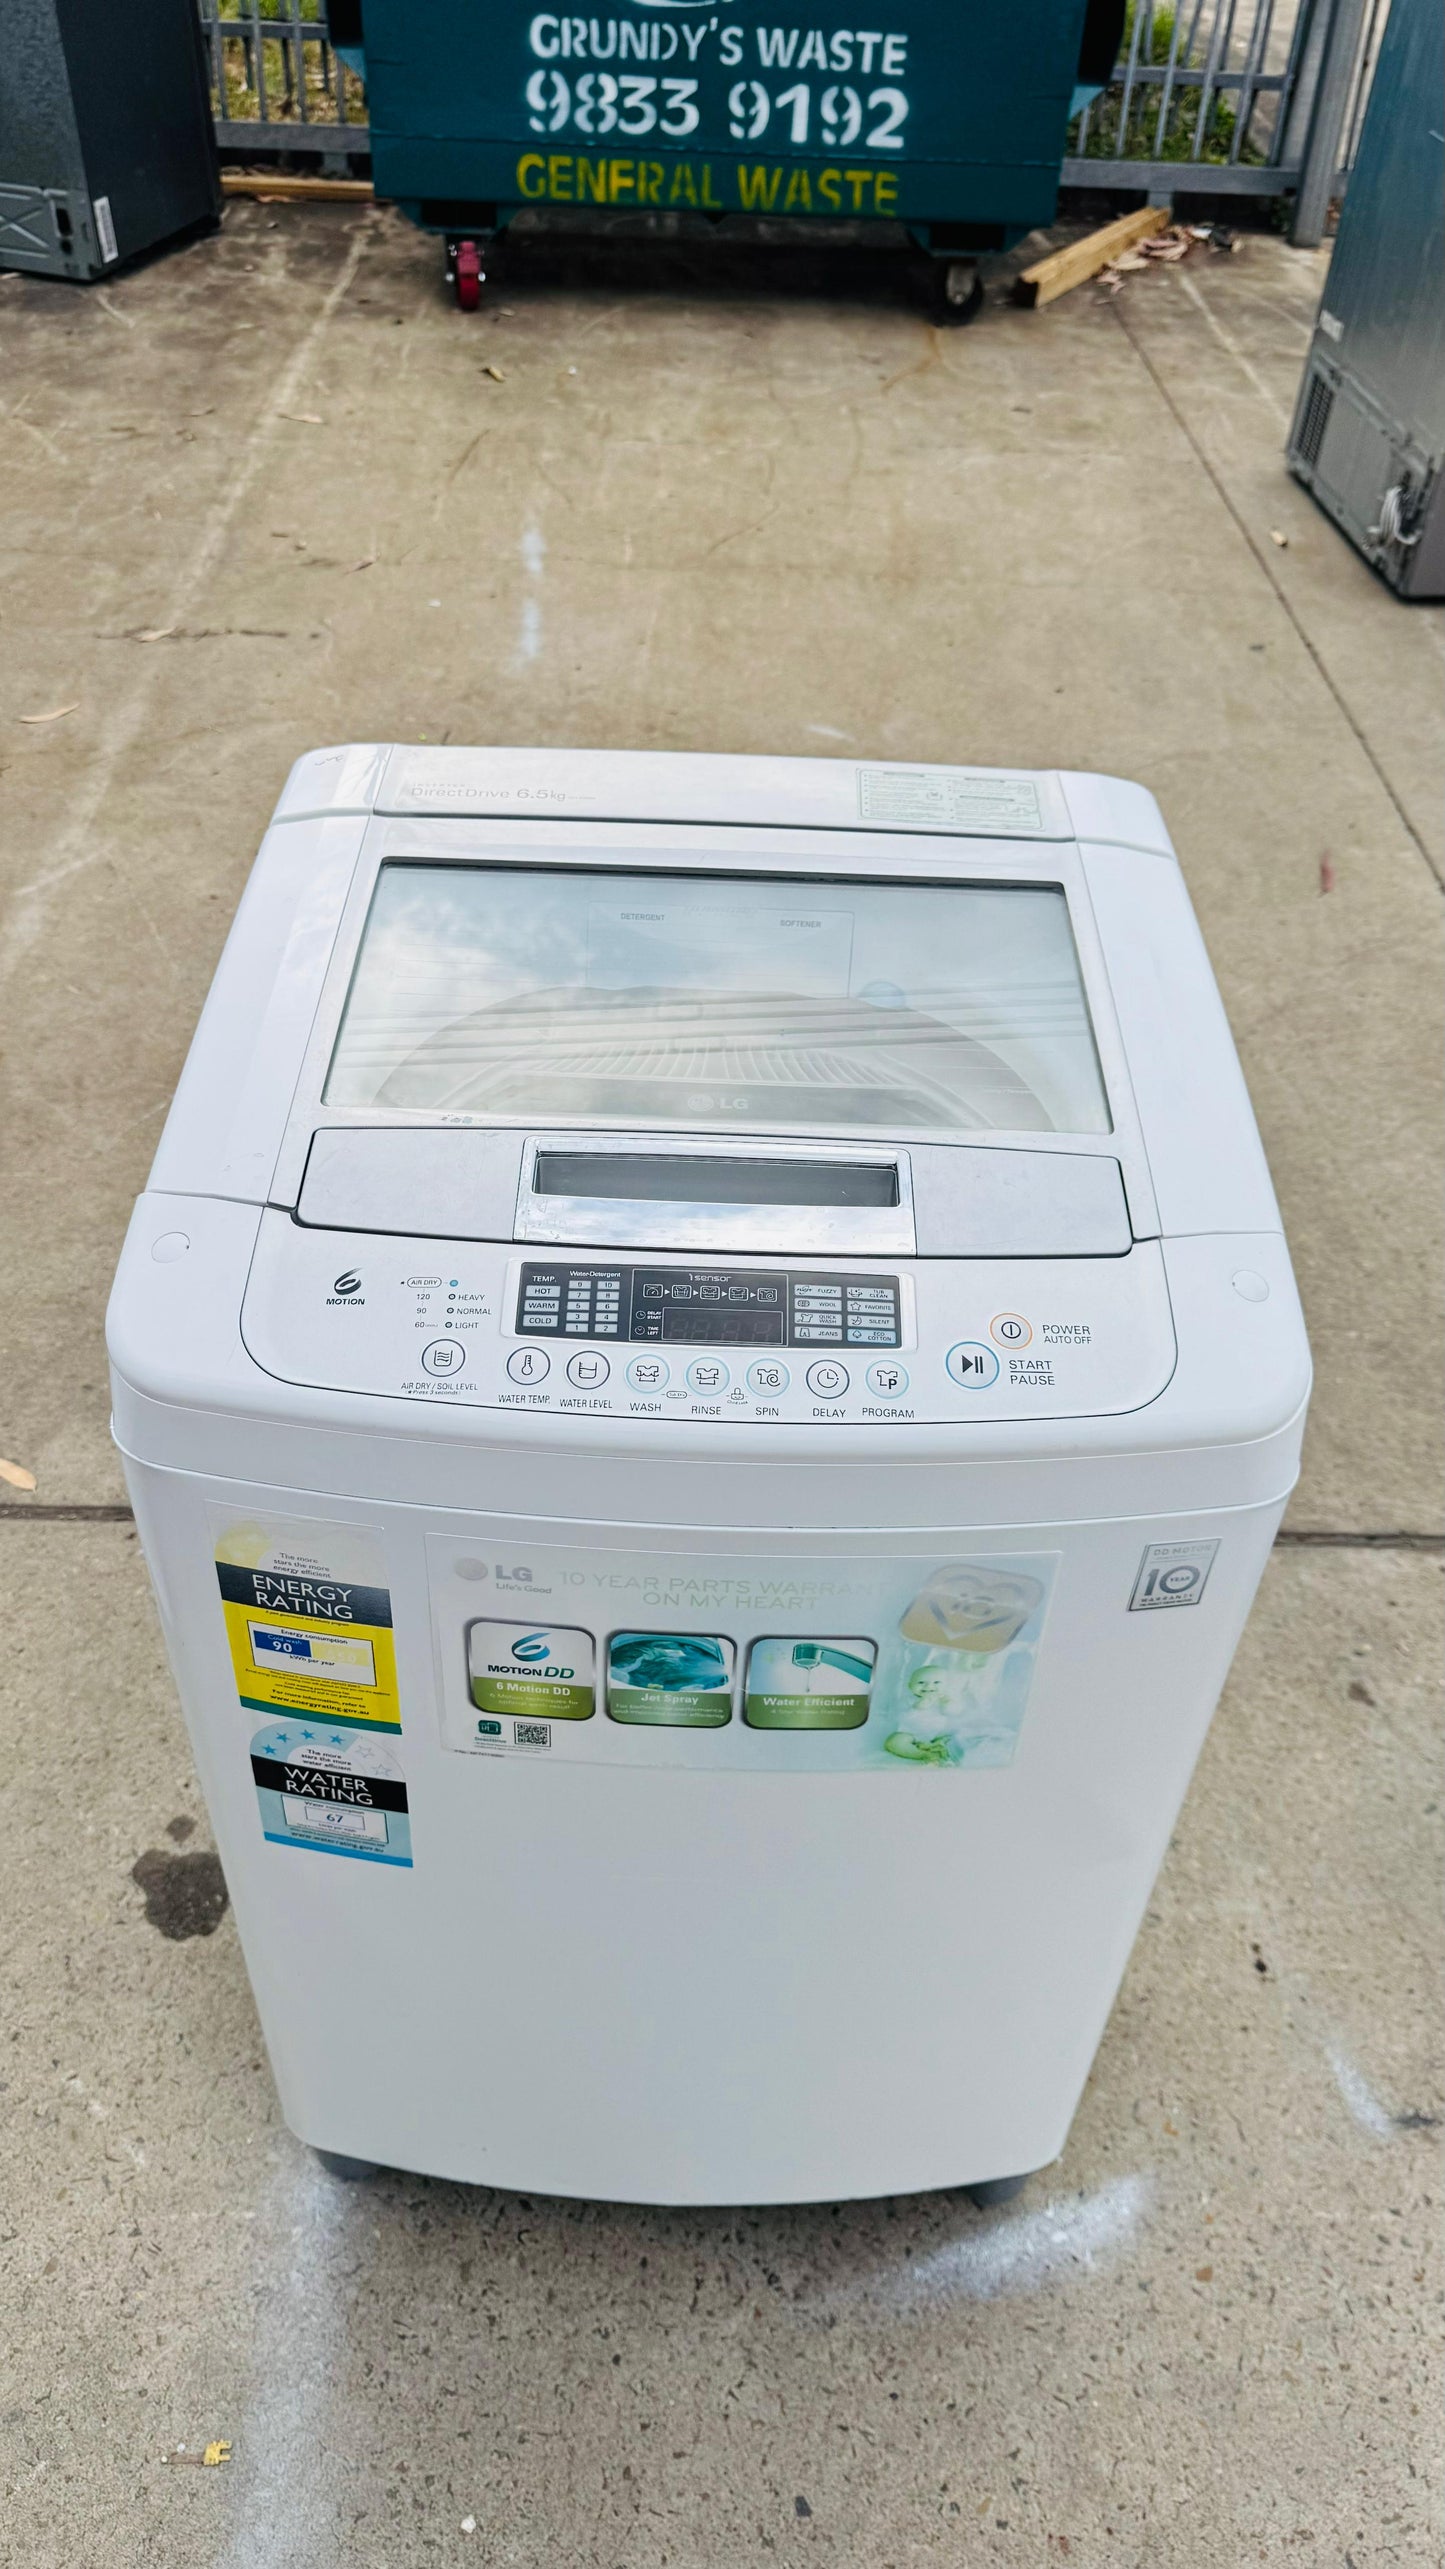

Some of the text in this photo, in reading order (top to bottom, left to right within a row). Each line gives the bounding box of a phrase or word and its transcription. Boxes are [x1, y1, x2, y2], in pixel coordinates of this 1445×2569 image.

[529, 14, 910, 76] GRUNDY'S WASTE
[525, 69, 911, 150] 9833 9192
[516, 152, 900, 217] GENERAL WASTE
[620, 912, 666, 922] DETERGENT
[780, 919, 822, 929] SOFTENER
[719, 1097, 749, 1110] LG
[532, 1275, 557, 1283] TEMP.
[534, 1287, 552, 1295] HOT
[326, 1298, 366, 1306] MOTION
[528, 1317, 552, 1325] COLD
[1042, 1324, 1091, 1335] POWER
[1044, 1336, 1092, 1344] AUTO OFF
[1009, 1360, 1053, 1370] START
[1010, 1375, 1055, 1386] PAUSE
[456, 1383, 478, 1391] LEVEL
[498, 1394, 551, 1404] WATER TEMP.
[560, 1399, 613, 1409] WATER LEVEL
[630, 1402, 662, 1412] WASH
[691, 1406, 722, 1415] RINSE
[756, 1407, 779, 1417] SPIN
[812, 1408, 846, 1417] DELAY
[862, 1408, 914, 1419] PROGRAM
[273, 1565, 299, 1574] energy
[496, 1565, 533, 1582] LG
[559, 1571, 585, 1586] 10
[593, 1573, 658, 1591] YEAR
[669, 1577, 751, 1595] PARTS
[1144, 1565, 1201, 1596] 10
[251, 1574, 353, 1602] ENERGY
[524, 1585, 552, 1594] Good
[255, 1591, 353, 1619] RATING
[642, 1591, 819, 1610] ON MY HEART
[281, 1629, 303, 1638] Energy
[272, 1640, 292, 1653] 90
[487, 1664, 575, 1679] MOTION DD
[496, 1681, 571, 1696] 6 Motion DD
[640, 1693, 699, 1705] Jet Spray
[763, 1697, 855, 1706] Water Efficient
[284, 1766, 369, 1792] WATER
[286, 1780, 373, 1805] RATING
[326, 1813, 343, 1823] 67
